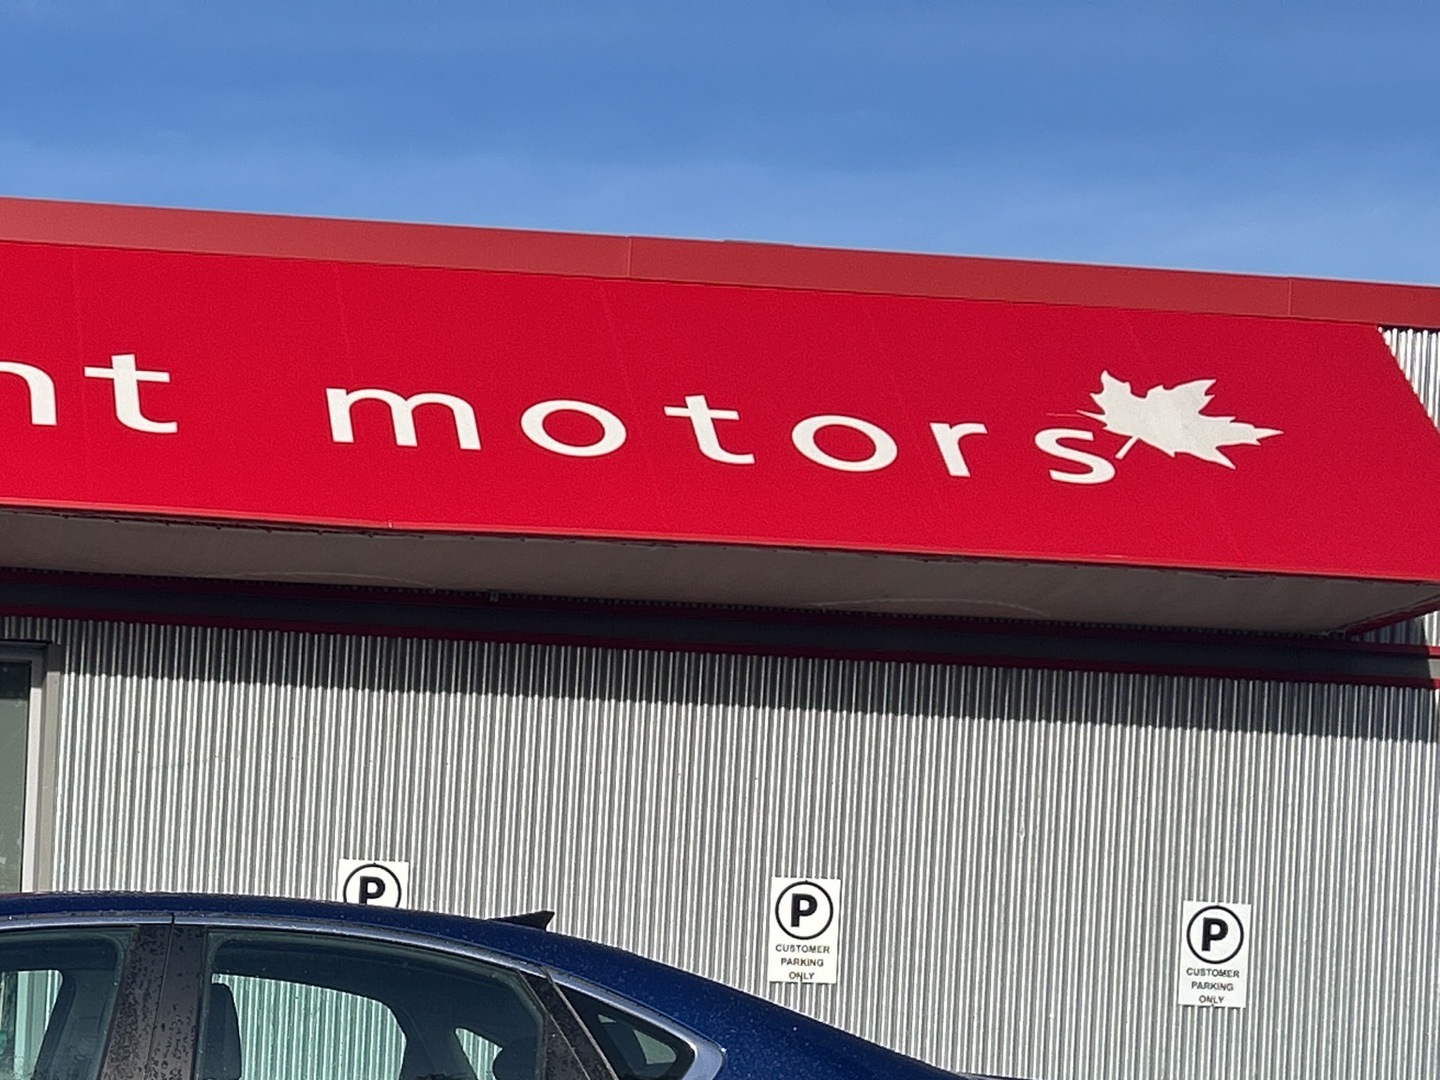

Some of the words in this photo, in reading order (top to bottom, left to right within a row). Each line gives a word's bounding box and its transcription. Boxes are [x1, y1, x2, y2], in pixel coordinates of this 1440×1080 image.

[325, 388, 1117, 485] motors
[359, 875, 386, 905] P
[790, 892, 818, 928] P
[1201, 916, 1229, 952] P
[774, 943, 831, 954] CUSTOMER
[780, 957, 825, 968] PARKING
[788, 971, 816, 981] ONLY
[1186, 966, 1240, 979] CUSTOMER
[1191, 980, 1235, 992] PARKING
[1198, 994, 1225, 1005] ONLY
